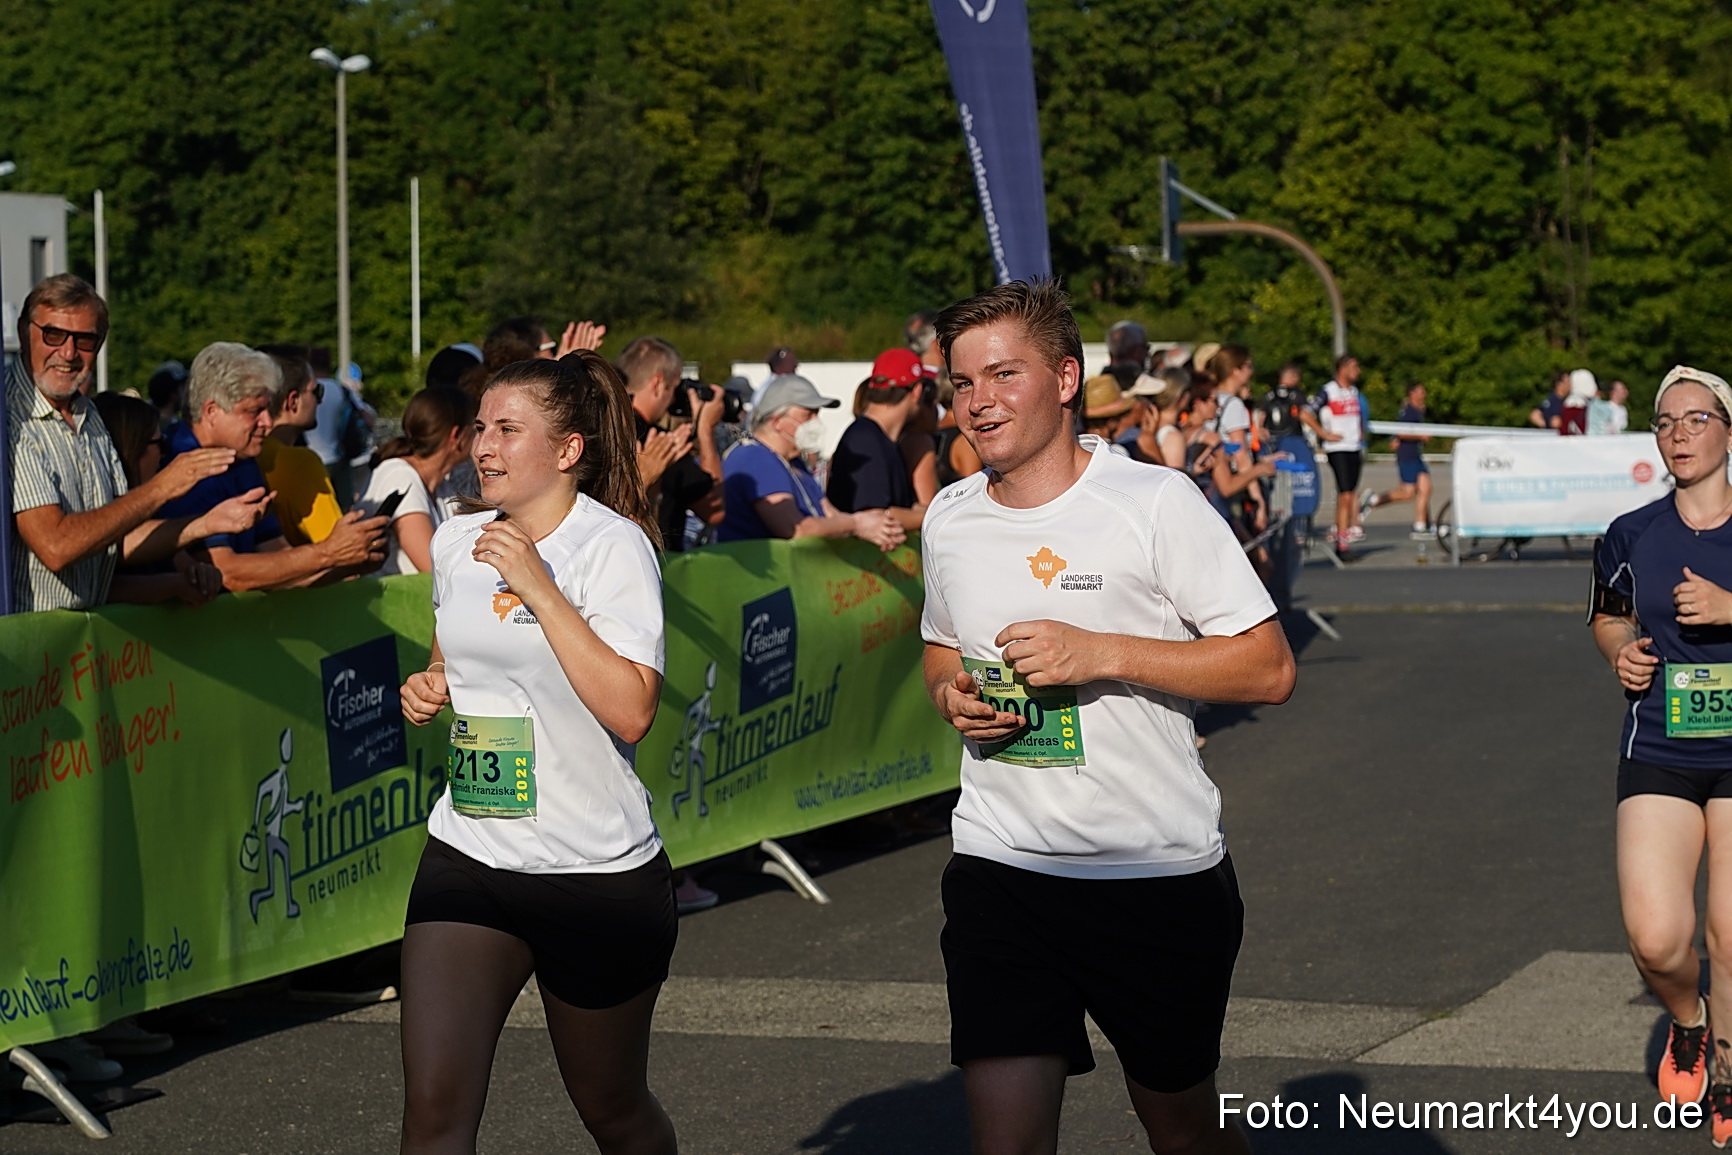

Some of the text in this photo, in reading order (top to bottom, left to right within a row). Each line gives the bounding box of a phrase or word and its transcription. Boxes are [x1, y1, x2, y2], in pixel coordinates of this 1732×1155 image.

[1038, 562, 1053, 571] NM
[1061, 574, 1103, 583] LANDKREIS
[499, 598, 512, 607] NM
[1061, 583, 1103, 591] NEUMARKT
[514, 609, 534, 617] LAND
[750, 626, 791, 656] Fischer
[70, 641, 154, 702] Firmen
[338, 684, 386, 719] Fischer
[1671, 697, 1681, 724] RUN
[715, 664, 843, 777] firmenlauf
[1060, 702, 1076, 750] 2022
[10, 681, 181, 805] laufen länger!
[454, 748, 501, 783] 213
[515, 757, 529, 802] 2022
[472, 784, 516, 796] Franziska
[713, 763, 768, 806] neumarkt
[302, 747, 445, 869] firmenla
[307, 847, 382, 904] neumarkt
[0, 926, 194, 1025] enlauf-oberpfalz.de
